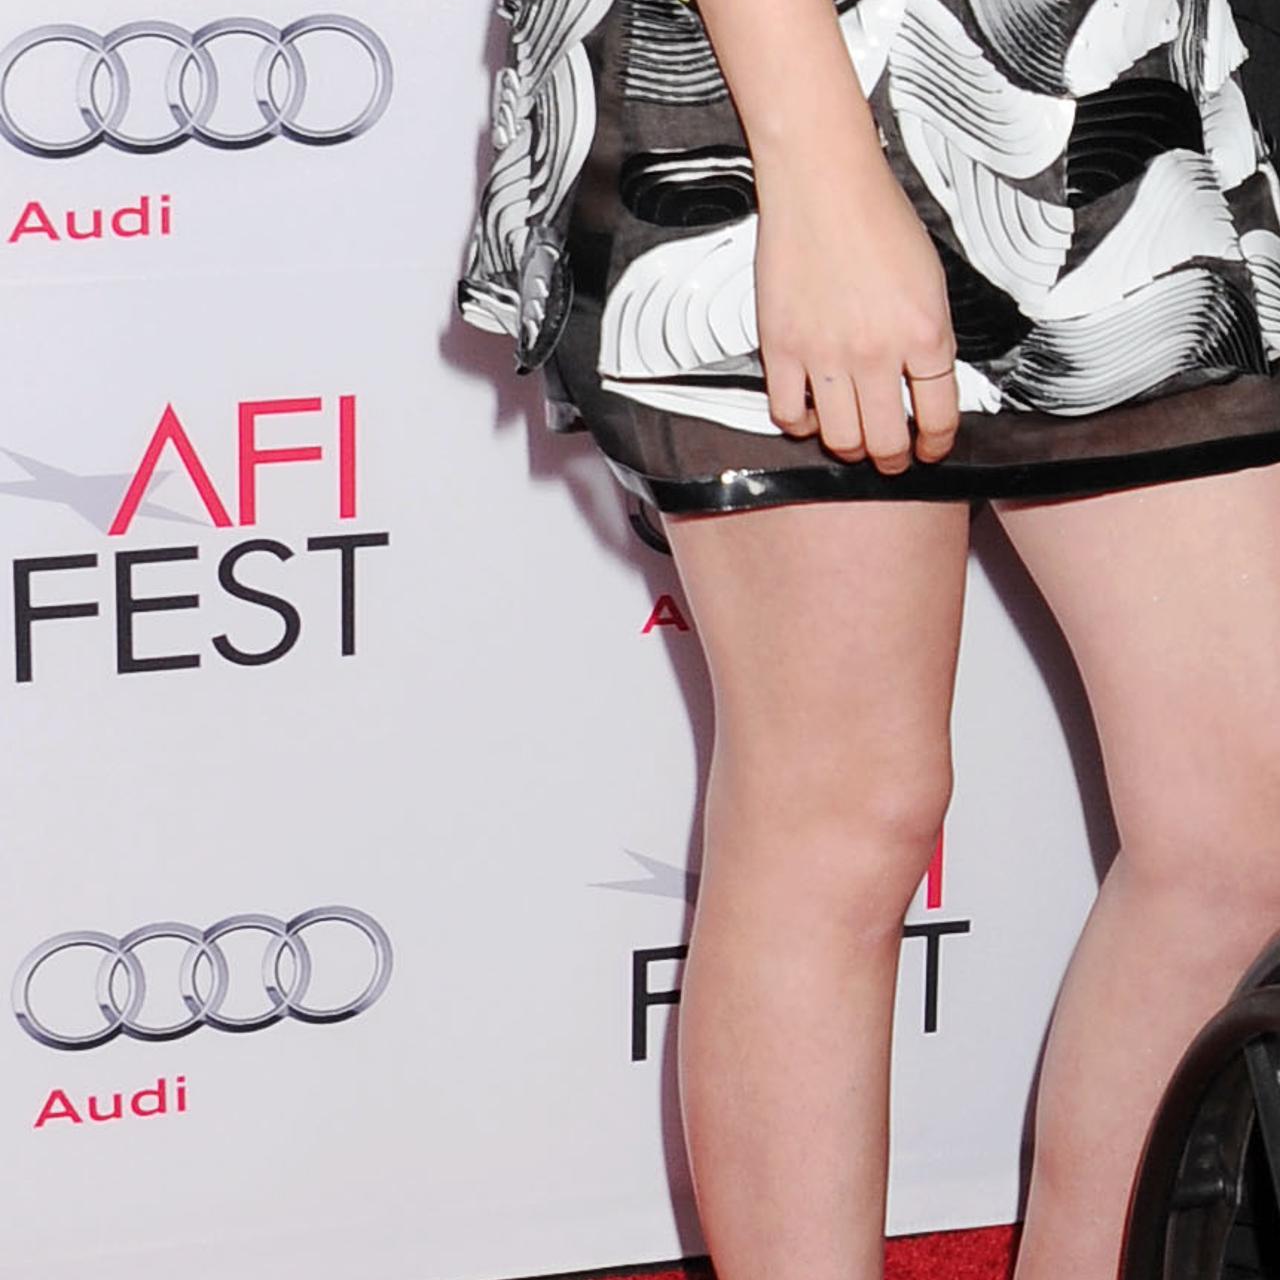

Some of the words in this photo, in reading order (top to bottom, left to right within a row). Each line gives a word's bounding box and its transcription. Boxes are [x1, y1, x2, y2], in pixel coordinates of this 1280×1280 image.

[8, 194, 172, 244] Audi
[108, 394, 358, 536] AFI
[13, 532, 390, 682] FEST
[33, 1075, 188, 1128] Audi
